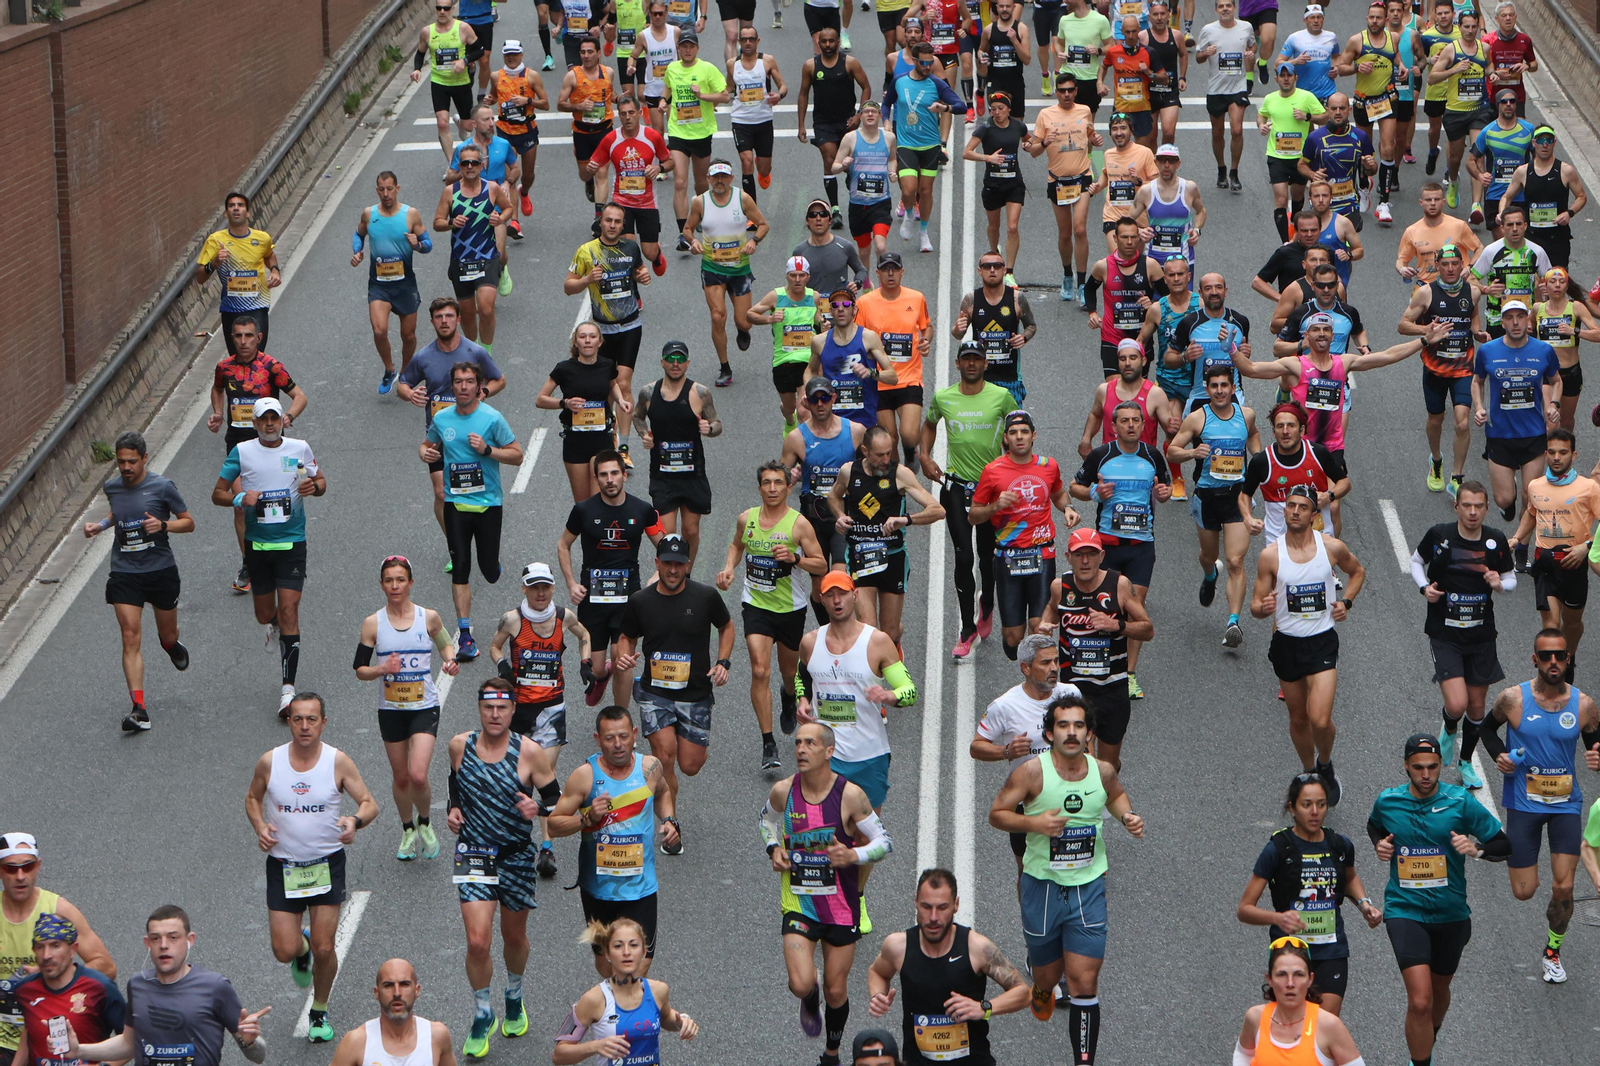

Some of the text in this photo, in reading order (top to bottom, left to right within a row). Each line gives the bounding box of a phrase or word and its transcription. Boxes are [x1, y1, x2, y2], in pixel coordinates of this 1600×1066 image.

[619, 160, 645, 169] ASSA
[531, 641, 553, 650] FILA
[410, 658, 418, 668] C
[278, 804, 325, 813] FRANCE
[1412, 847, 1439, 855] ZURICH
[932, 1032, 951, 1040] 4262
[627, 1054, 654, 1064] ZURICH
